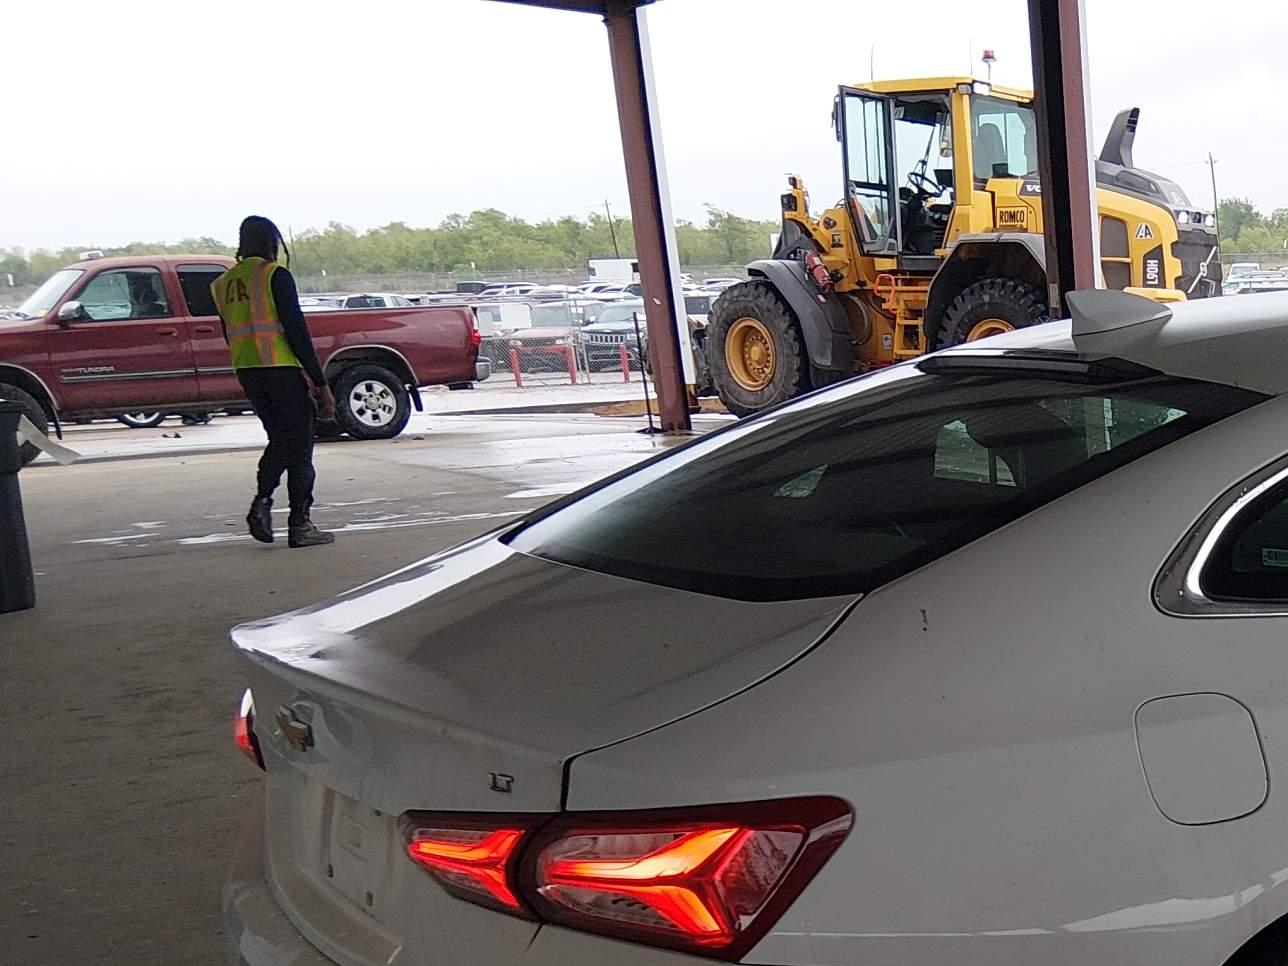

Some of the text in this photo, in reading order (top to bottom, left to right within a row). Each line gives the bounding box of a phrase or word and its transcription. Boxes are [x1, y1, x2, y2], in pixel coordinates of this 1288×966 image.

[999, 210, 1025, 224] ROMCO
[1146, 259, 1159, 285] L90H
[488, 771, 514, 794] LT
